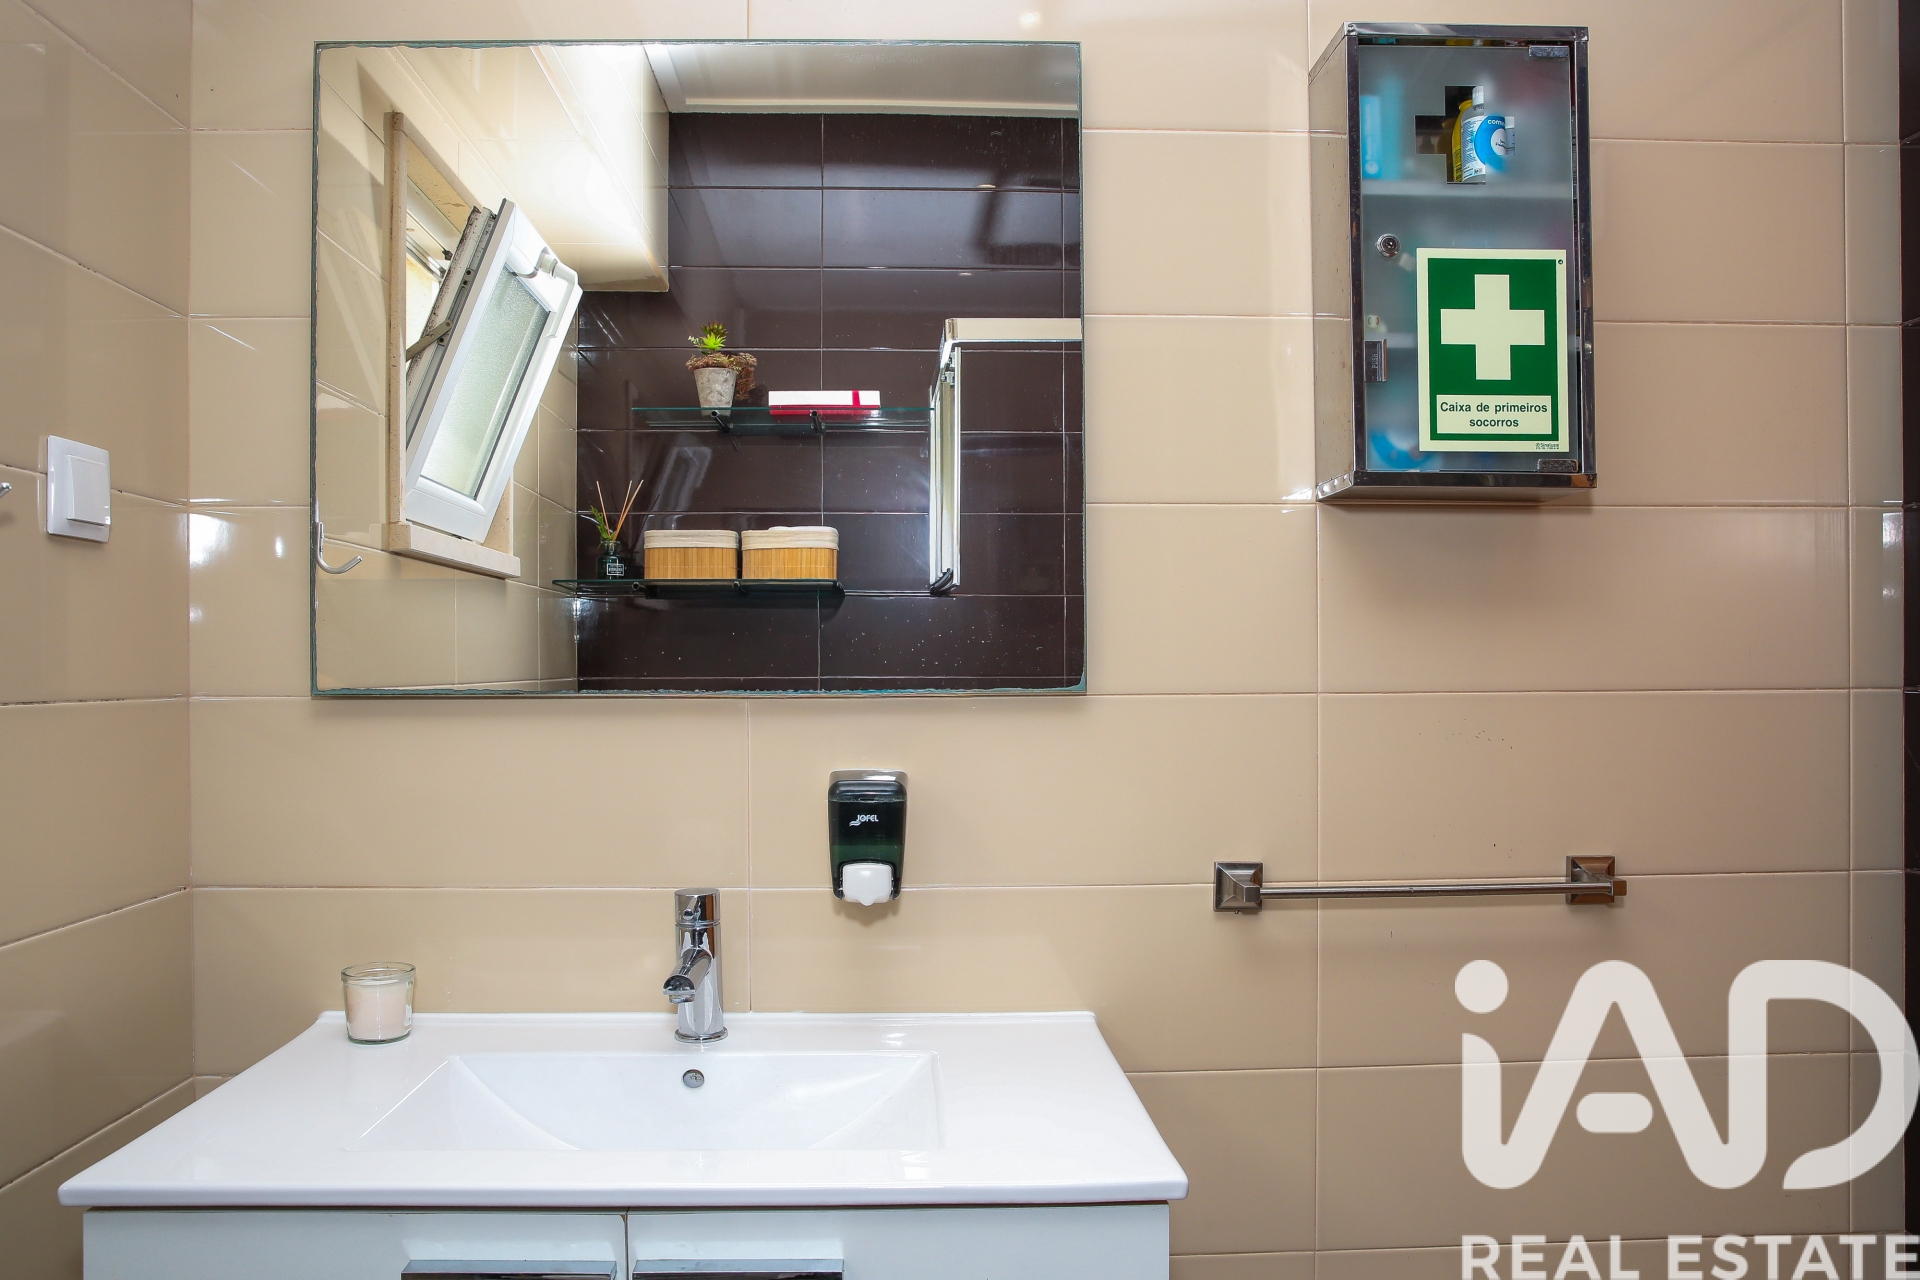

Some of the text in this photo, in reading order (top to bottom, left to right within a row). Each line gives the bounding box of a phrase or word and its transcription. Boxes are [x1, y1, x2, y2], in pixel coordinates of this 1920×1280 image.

[1440, 401, 1548, 415] Caixa de primeiros
[1469, 418, 1519, 427] socorros
[856, 814, 879, 822] JOFEL
